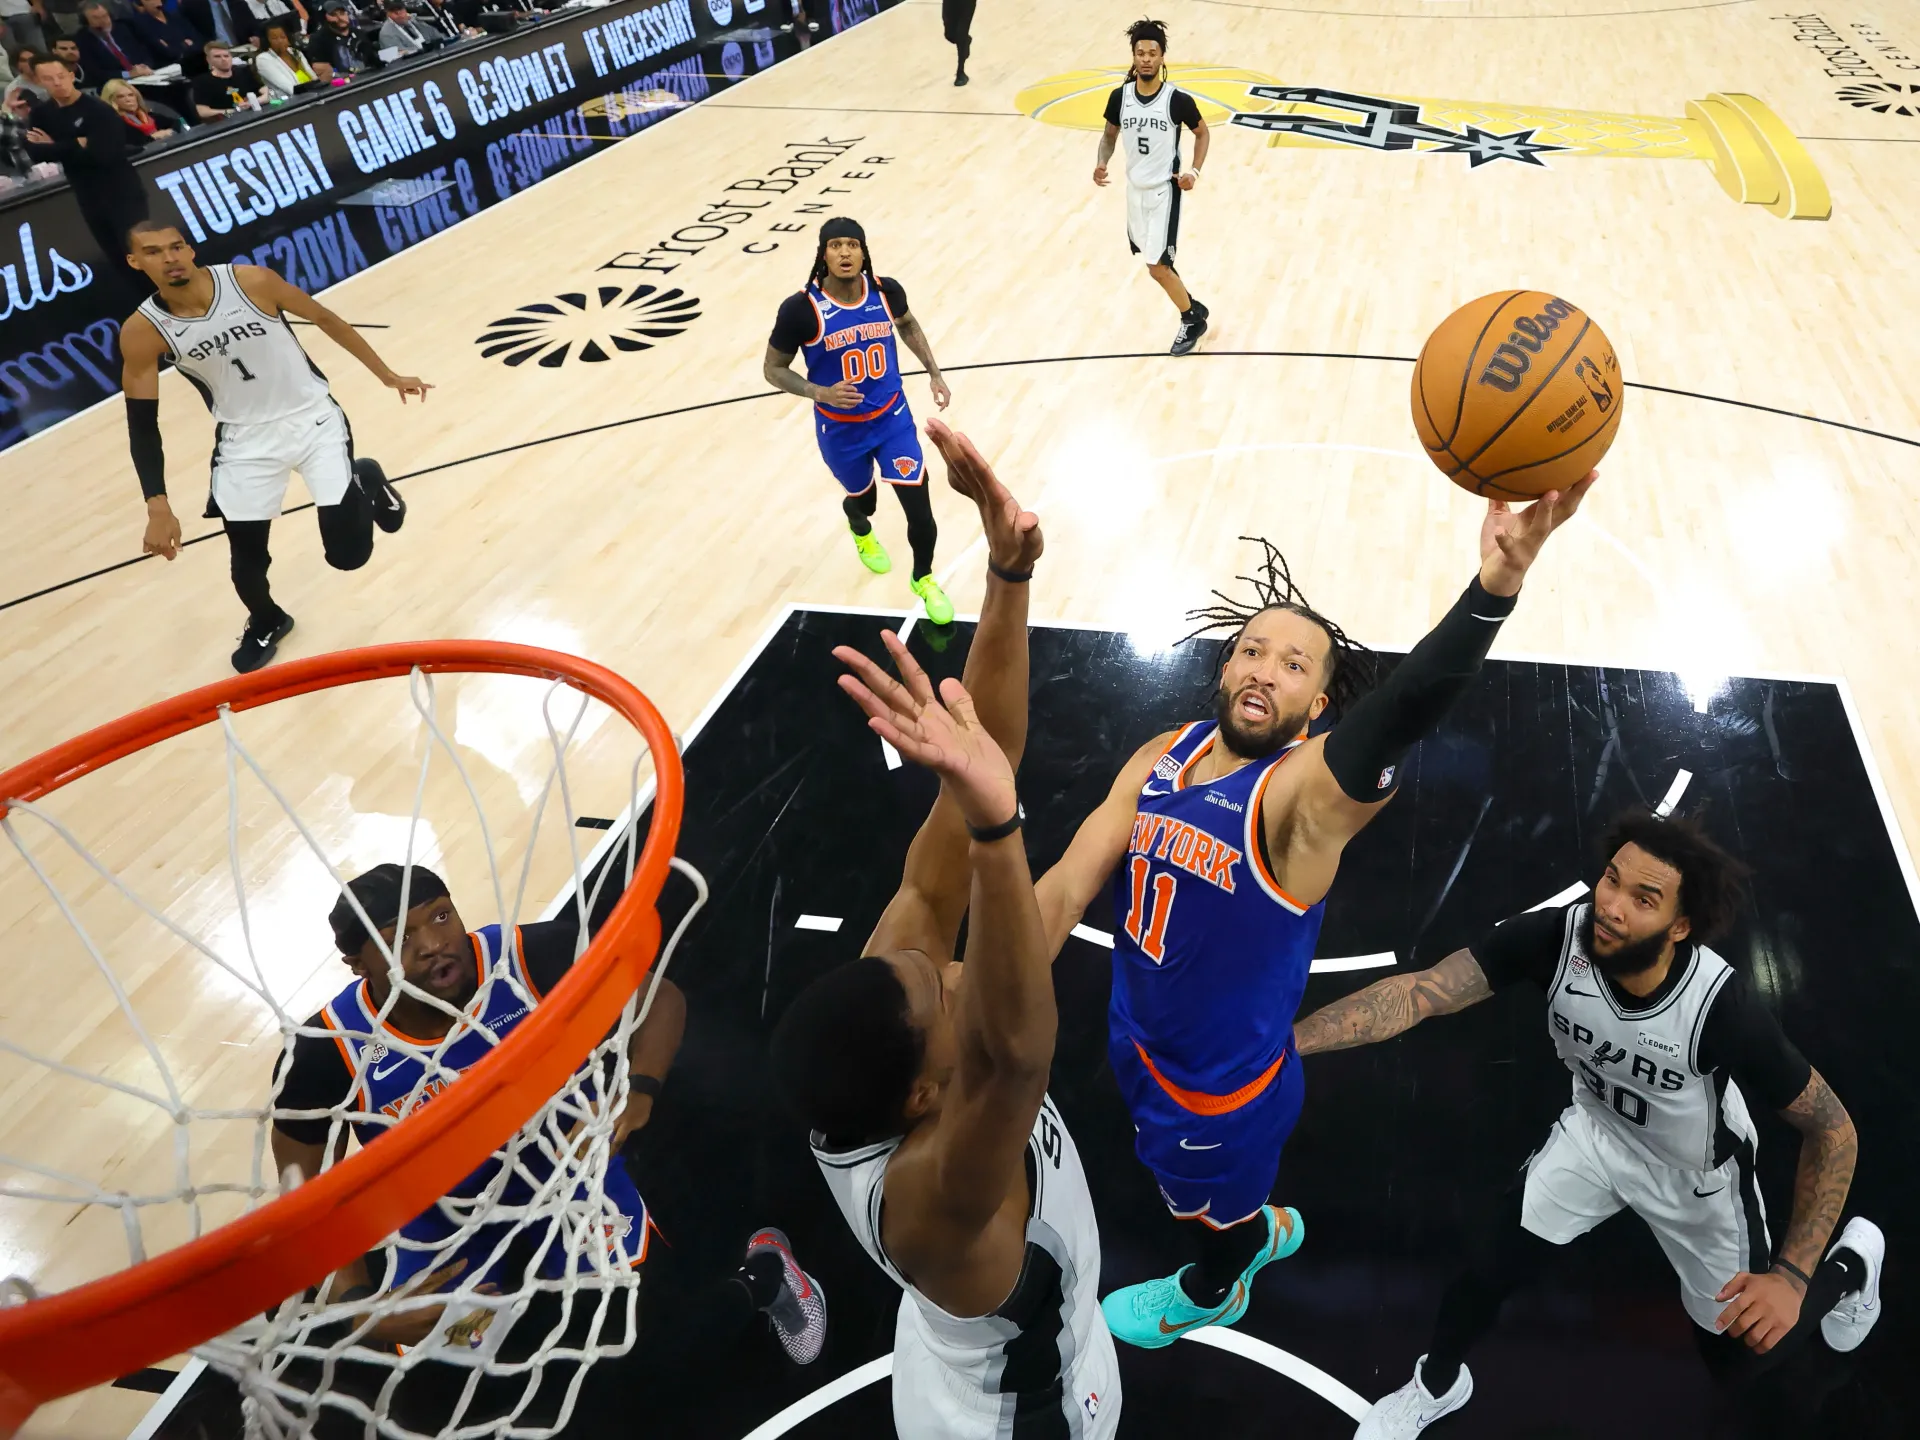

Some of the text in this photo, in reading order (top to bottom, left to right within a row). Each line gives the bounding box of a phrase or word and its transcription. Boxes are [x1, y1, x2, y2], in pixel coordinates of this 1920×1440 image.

[1768, 13, 1883, 79] Frost Bank
[1850, 23, 1920, 70] CENTER
[155, 0, 696, 243] TUESDAY GAME 6 8:30PM ET IF NECESSARY
[1122, 117, 1168, 132] SPURS
[1138, 137, 1150, 155] 5
[595, 136, 866, 275] Frost Bank
[743, 156, 896, 254] CENTER
[187, 322, 267, 361] SPURS
[824, 321, 892, 352] NEW YORK
[1478, 297, 1579, 393] Wilson
[231, 358, 255, 381] 1
[841, 343, 887, 385] 00
[1163, 756, 1178, 770] USA
[1218, 797, 1243, 813] dhabi
[1155, 815, 1243, 895] YORK
[1124, 854, 1177, 966] 11
[1553, 1011, 1685, 1092] SPURS
[1643, 1037, 1674, 1054] LEDGER
[1579, 1060, 1650, 1128] 30
